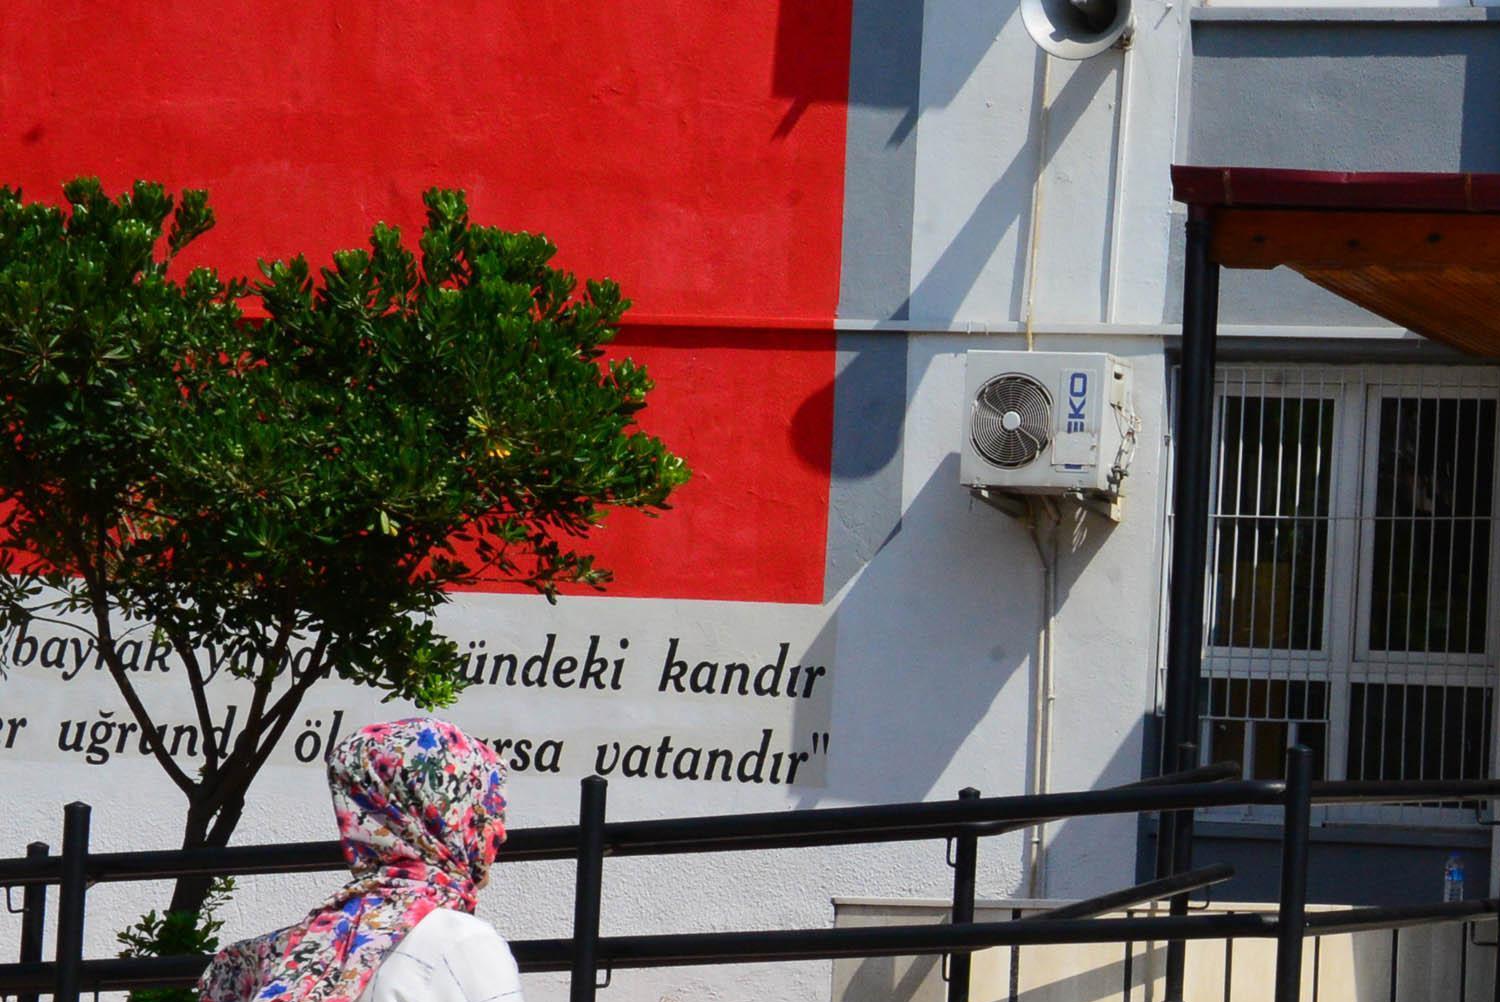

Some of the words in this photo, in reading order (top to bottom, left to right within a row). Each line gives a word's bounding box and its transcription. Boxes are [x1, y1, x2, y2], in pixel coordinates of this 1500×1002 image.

[1064, 373, 1087, 470] EKO
[658, 637, 827, 699] kandır
[57, 704, 240, 766] uğrund
